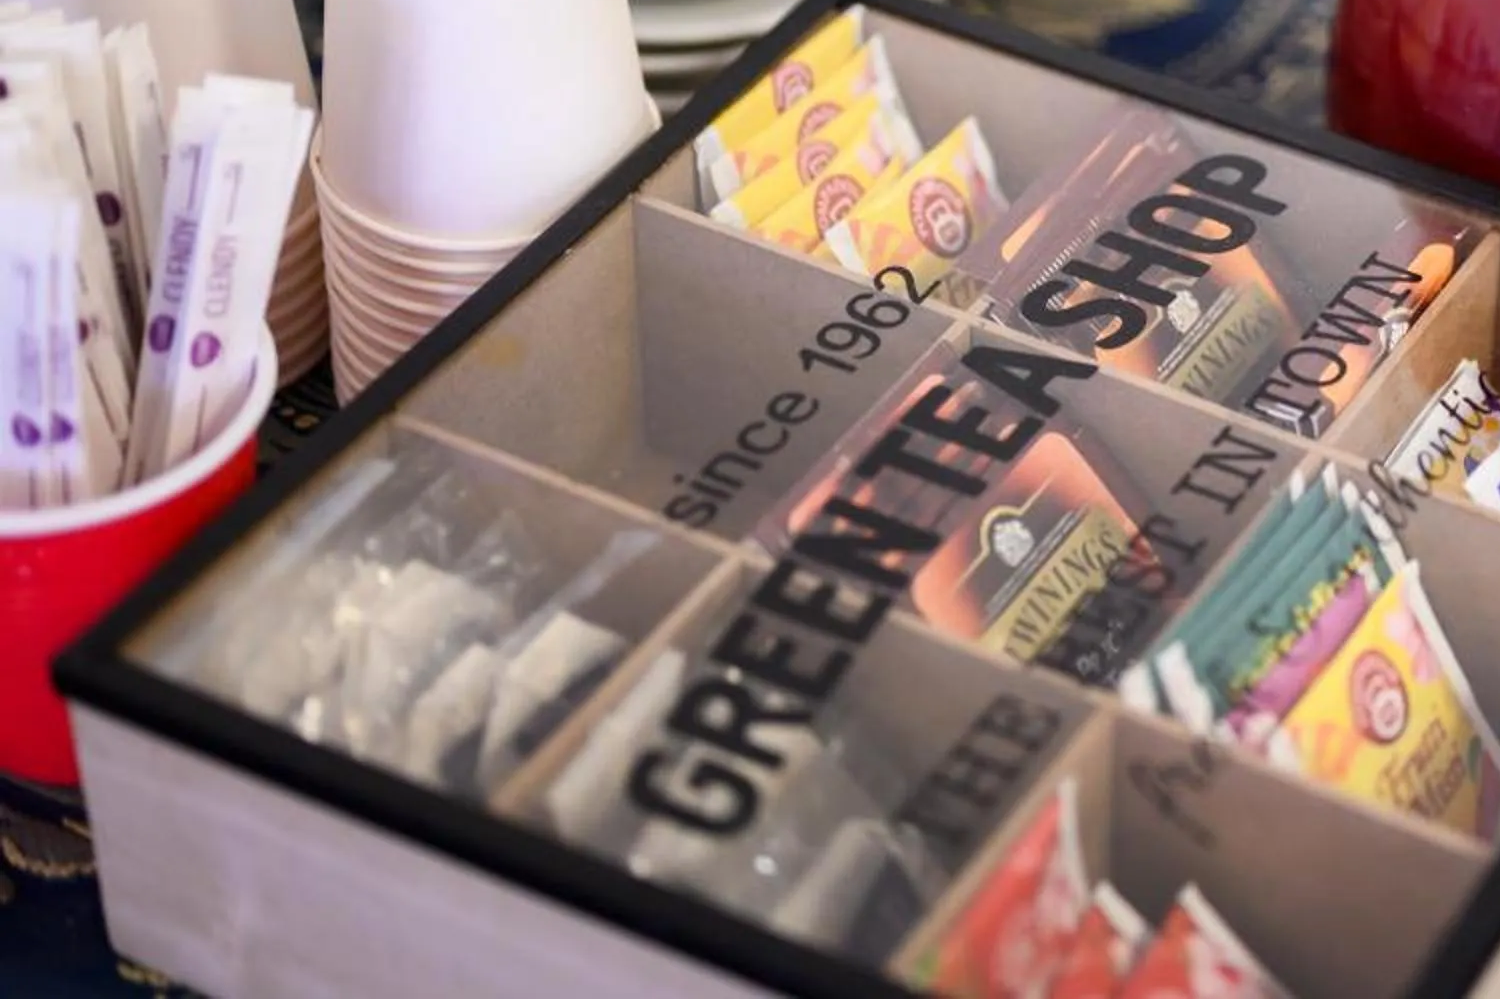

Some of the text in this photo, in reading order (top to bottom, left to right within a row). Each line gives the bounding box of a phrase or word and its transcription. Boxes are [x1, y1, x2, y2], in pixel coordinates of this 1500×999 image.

[626, 153, 1289, 840] GREEN TEA SHOP
[662, 387, 821, 529] since
[798, 266, 942, 376] 1962
[889, 691, 1063, 846] THE
[1170, 425, 1279, 514] IN
[1244, 250, 1423, 419] TOWN
